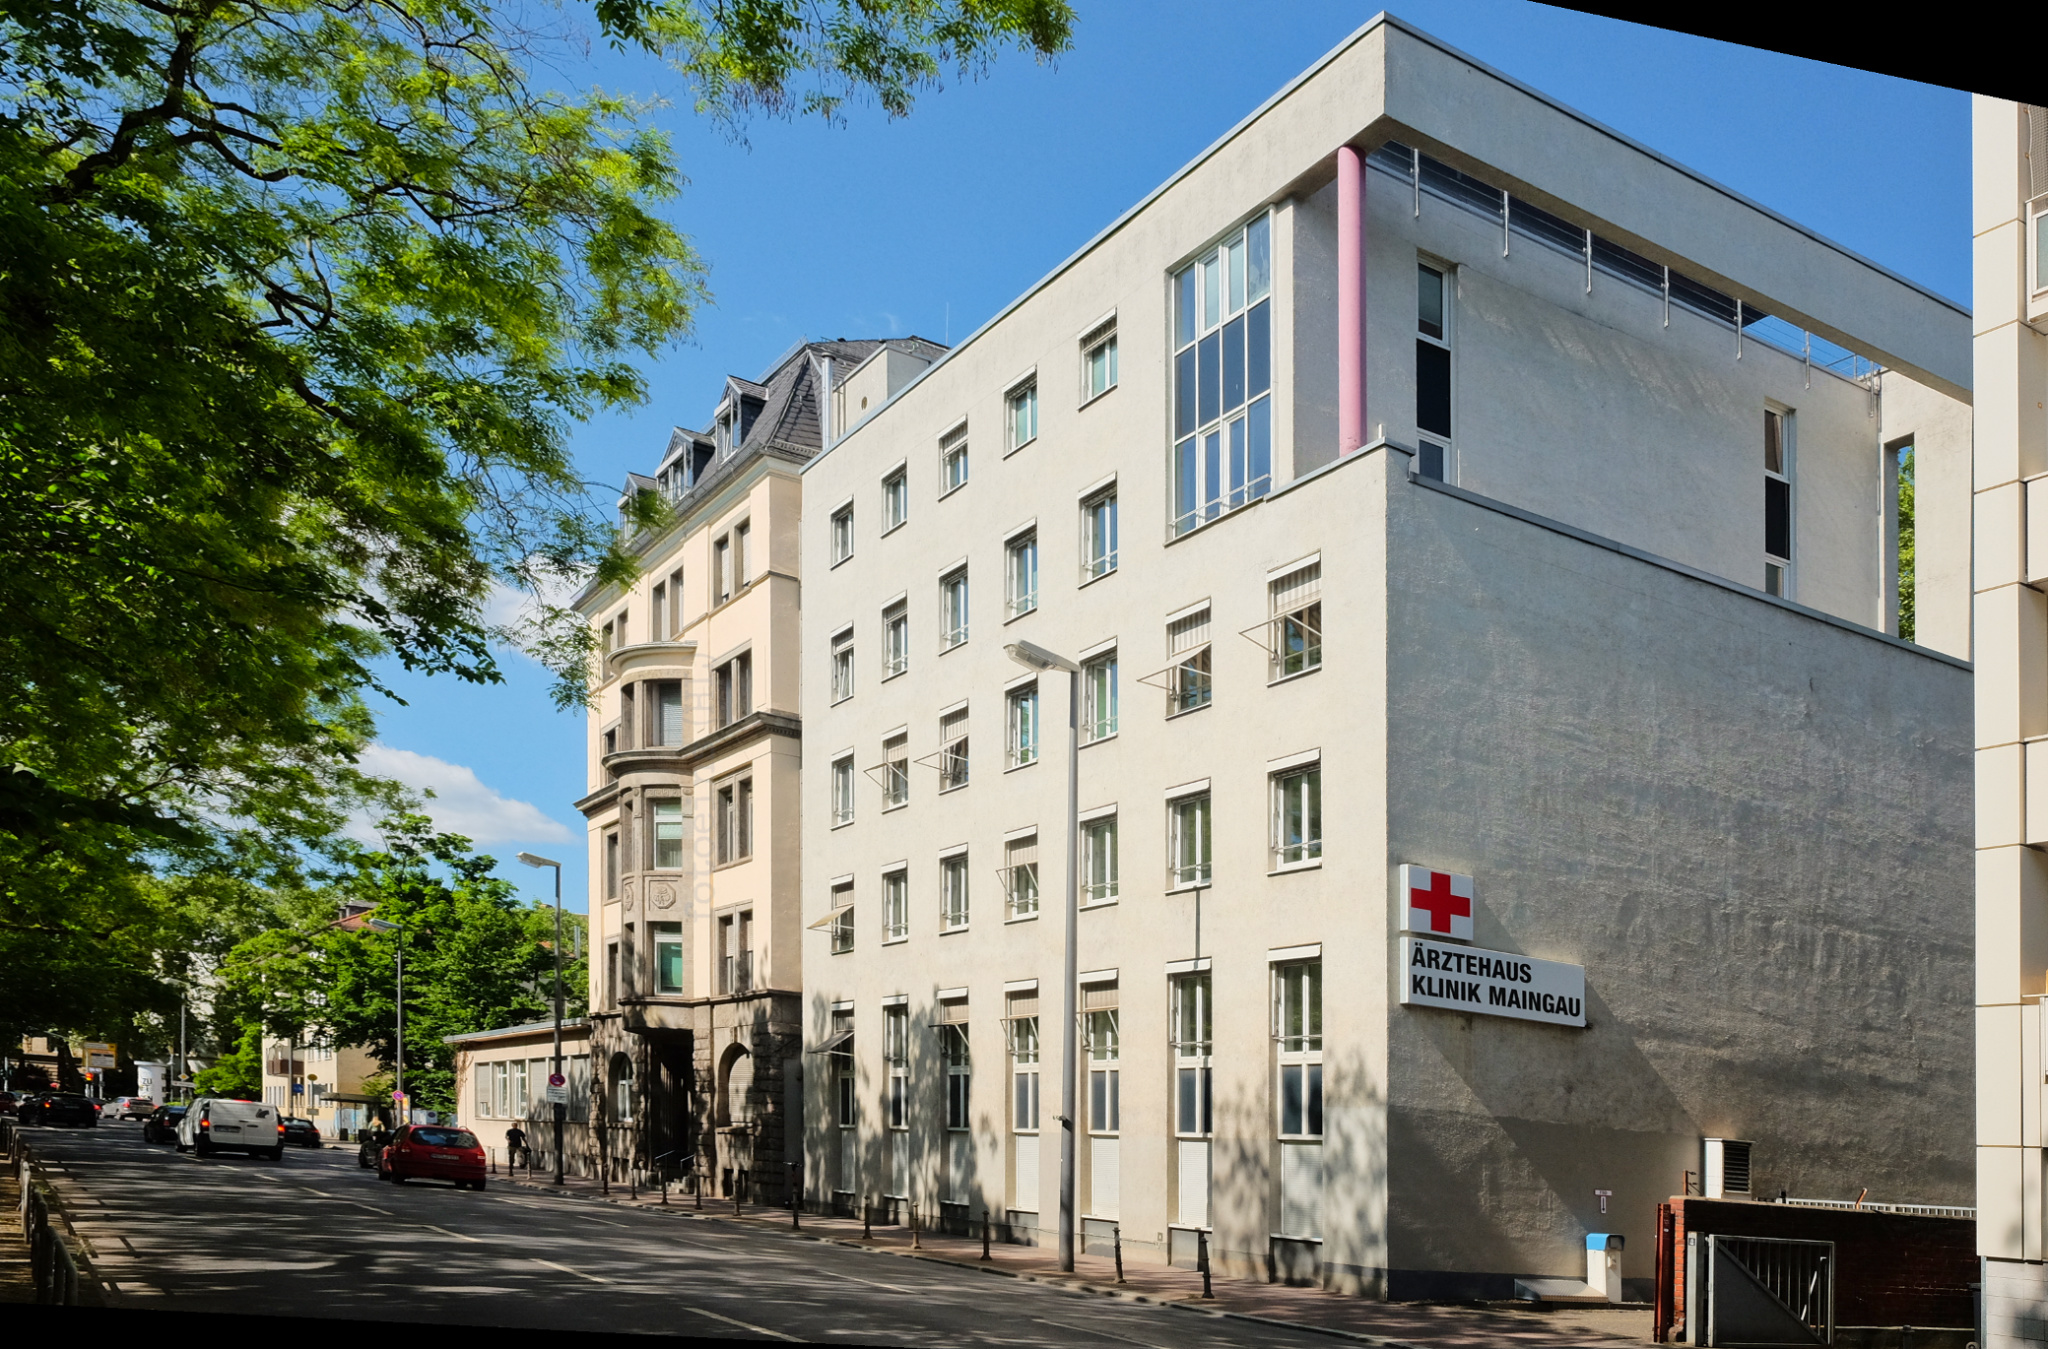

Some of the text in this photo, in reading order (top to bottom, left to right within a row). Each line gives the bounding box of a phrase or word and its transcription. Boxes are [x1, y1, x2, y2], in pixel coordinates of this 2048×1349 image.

[1411, 942, 1532, 984] ÄRZTEHAUS
[1412, 974, 1581, 1017] KLINIK MAINGAU
